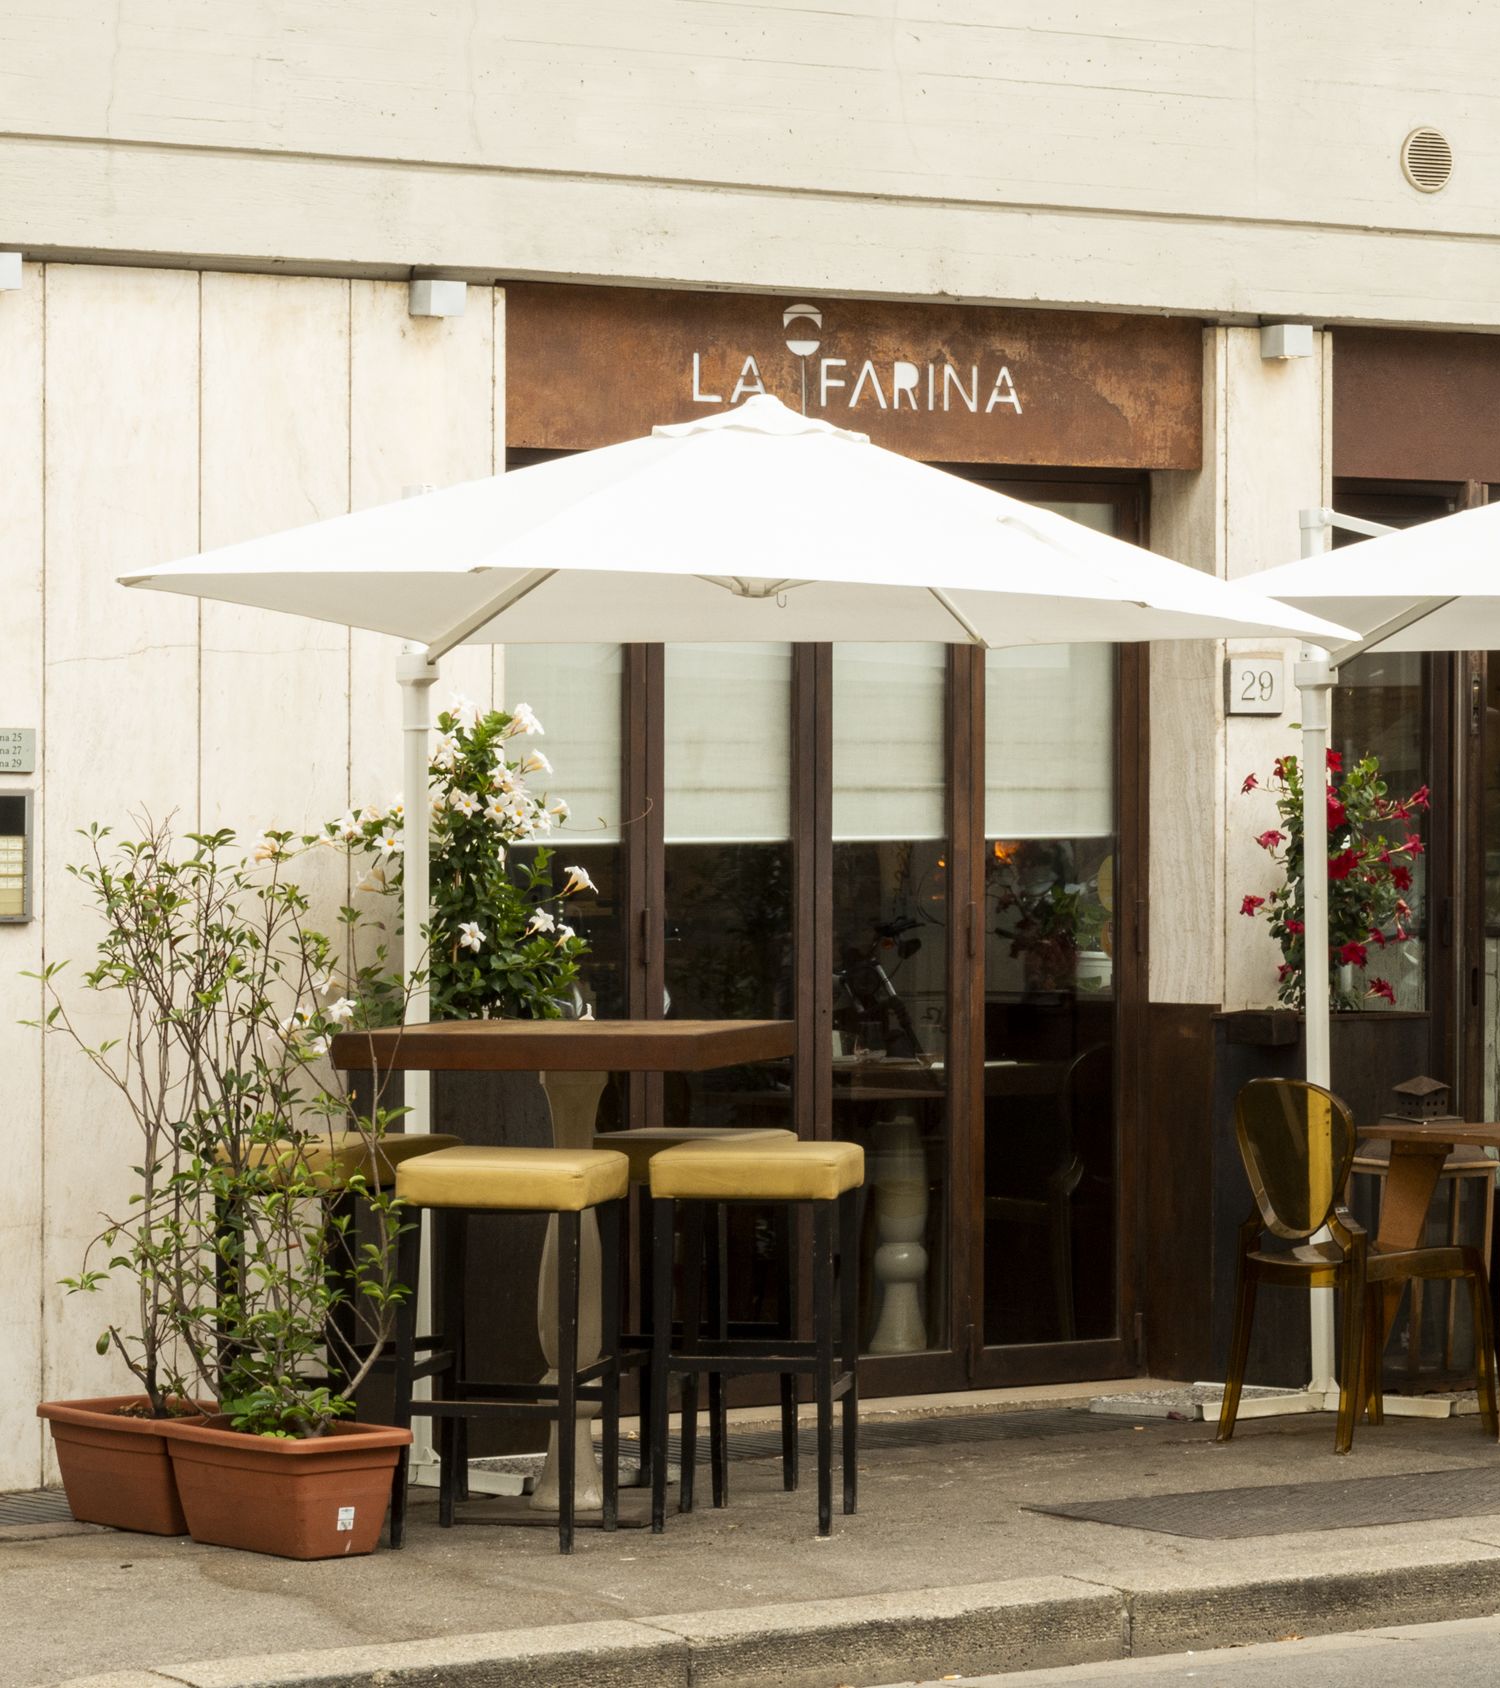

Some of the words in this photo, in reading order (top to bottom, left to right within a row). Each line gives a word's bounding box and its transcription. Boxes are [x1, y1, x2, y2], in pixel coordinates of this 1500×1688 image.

[692, 352, 767, 403] LA
[820, 358, 1023, 415] FARINA
[1241, 670, 1273, 702] 29
[12, 732, 22, 742] 25
[12, 745, 22, 755] 27
[11, 758, 22, 768] 29
